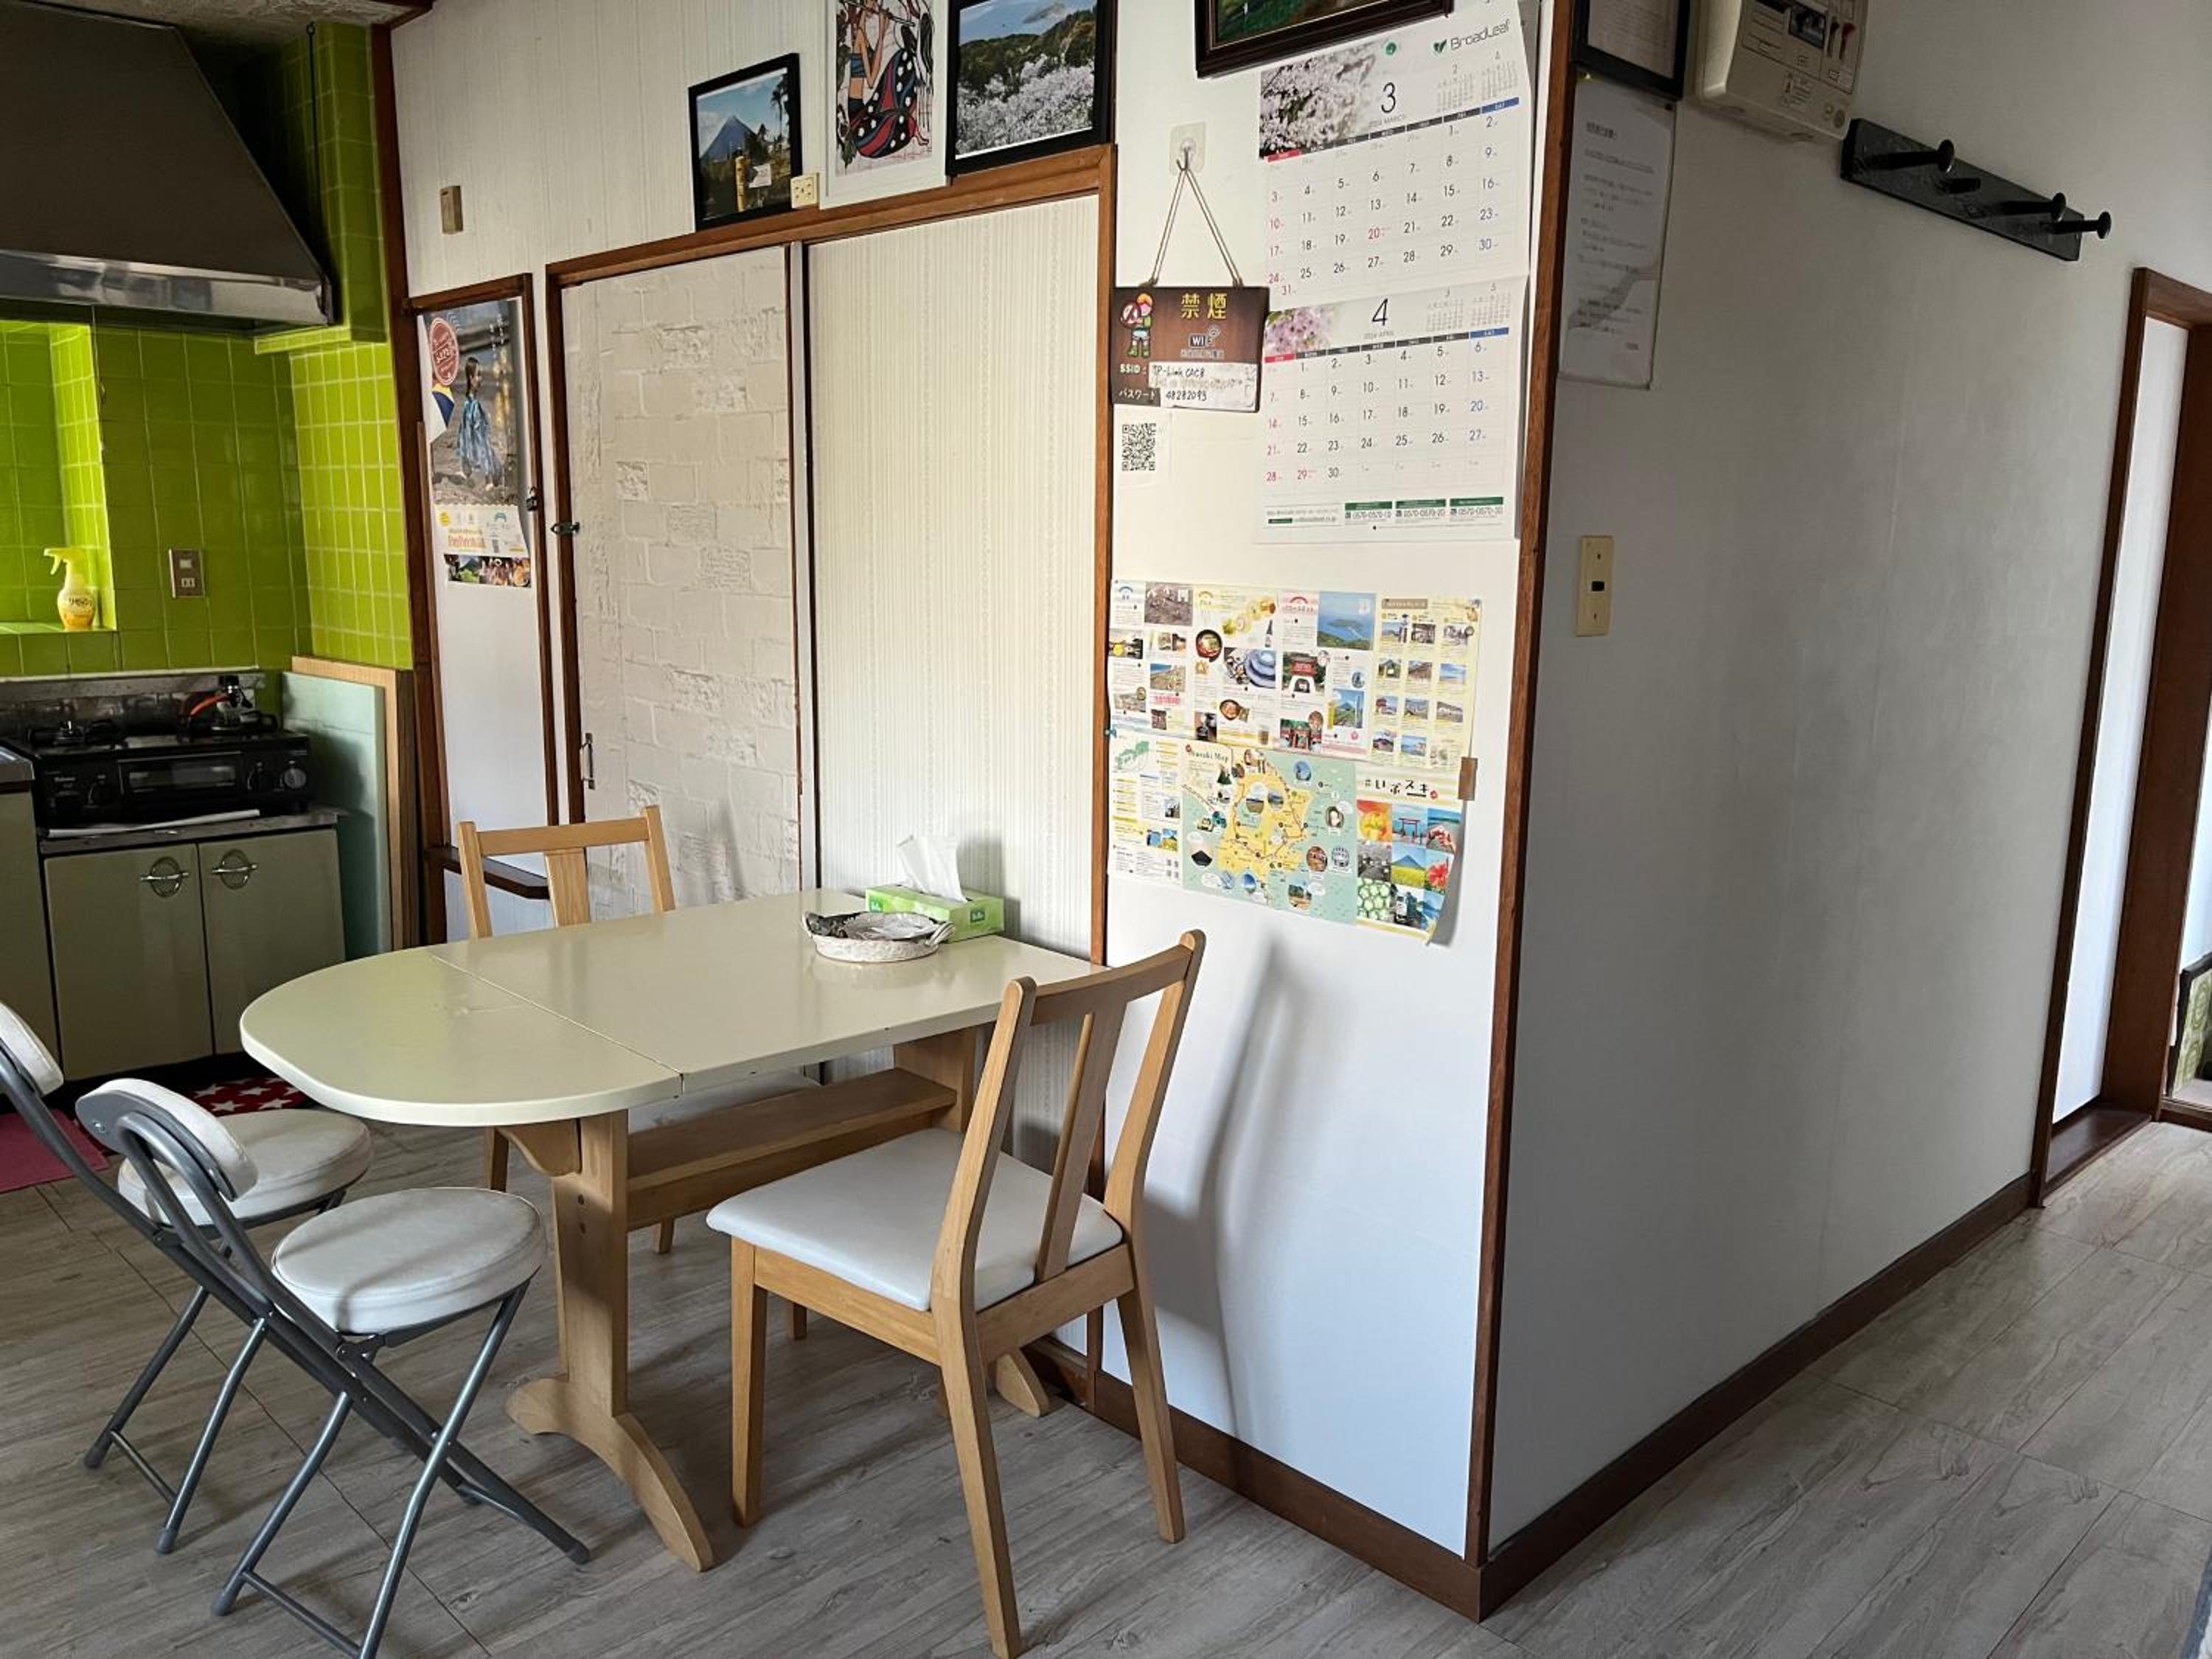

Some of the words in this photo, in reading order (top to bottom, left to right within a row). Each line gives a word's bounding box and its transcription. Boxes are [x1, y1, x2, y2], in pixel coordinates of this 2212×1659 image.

[1381, 82, 1397, 114] 3
[1450, 125, 1453, 136] 1
[1486, 116, 1492, 128] 2
[1272, 192, 1278, 203] 3
[1304, 185, 1310, 195] 4
[1338, 178, 1344, 189] 5
[1373, 171, 1380, 181] 6
[1410, 163, 1415, 174] 7
[1446, 155, 1453, 167] 8
[1485, 147, 1492, 158] 9
[1270, 218, 1279, 229] 10
[1303, 212, 1312, 224] 11
[1335, 206, 1346, 217] 12
[1371, 198, 1381, 211] 13
[1406, 192, 1417, 204] 14
[1444, 184, 1455, 197] 15
[1482, 177, 1495, 189] 16
[1270, 246, 1279, 257] 17
[1302, 240, 1312, 251] 18
[1335, 234, 1346, 245] 19
[1368, 227, 1380, 240] 20
[1404, 220, 1415, 233] 21
[1441, 215, 1453, 227] 22
[1480, 208, 1492, 220] 23
[1268, 273, 1279, 283] 24
[1300, 267, 1312, 279] 25
[1333, 262, 1346, 274] 26
[1368, 256, 1380, 268] 27
[1403, 251, 1415, 262] 28
[1440, 244, 1453, 257] 29
[1479, 238, 1492, 251] 30
[1281, 285, 1292, 295] 31
[1180, 293, 1227, 319] 禁煙
[1371, 298, 1388, 326] 4
[1301, 362, 1304, 372] 1
[1331, 358, 1338, 369] 2
[1365, 354, 1371, 365] 3
[1401, 350, 1407, 361] 4
[1437, 347, 1444, 357] 5
[1475, 341, 1481, 352] 6
[1119, 389, 1157, 402] パスワード
[1300, 389, 1305, 399] 8
[1331, 385, 1337, 396] 9
[1363, 382, 1374, 393] 10
[1399, 378, 1408, 389] 11
[1434, 375, 1446, 386] 12
[1472, 371, 1484, 383] 13
[1268, 418, 1277, 429] 14
[1298, 415, 1307, 426] 15
[1329, 413, 1340, 424] 16
[1363, 409, 1373, 421] 17
[1398, 406, 1408, 418] 18
[1434, 403, 1446, 415] 19
[1470, 400, 1484, 412] 20
[1267, 445, 1276, 456] 21
[1297, 442, 1307, 453] 22
[1328, 440, 1338, 451] 23
[1360, 437, 1372, 449] 24
[1396, 434, 1408, 446] 25
[1431, 433, 1444, 444] 26
[1470, 428, 1481, 442] 27
[1266, 471, 1276, 481] 28
[1297, 470, 1307, 480] 29
[1328, 467, 1339, 479] 30
